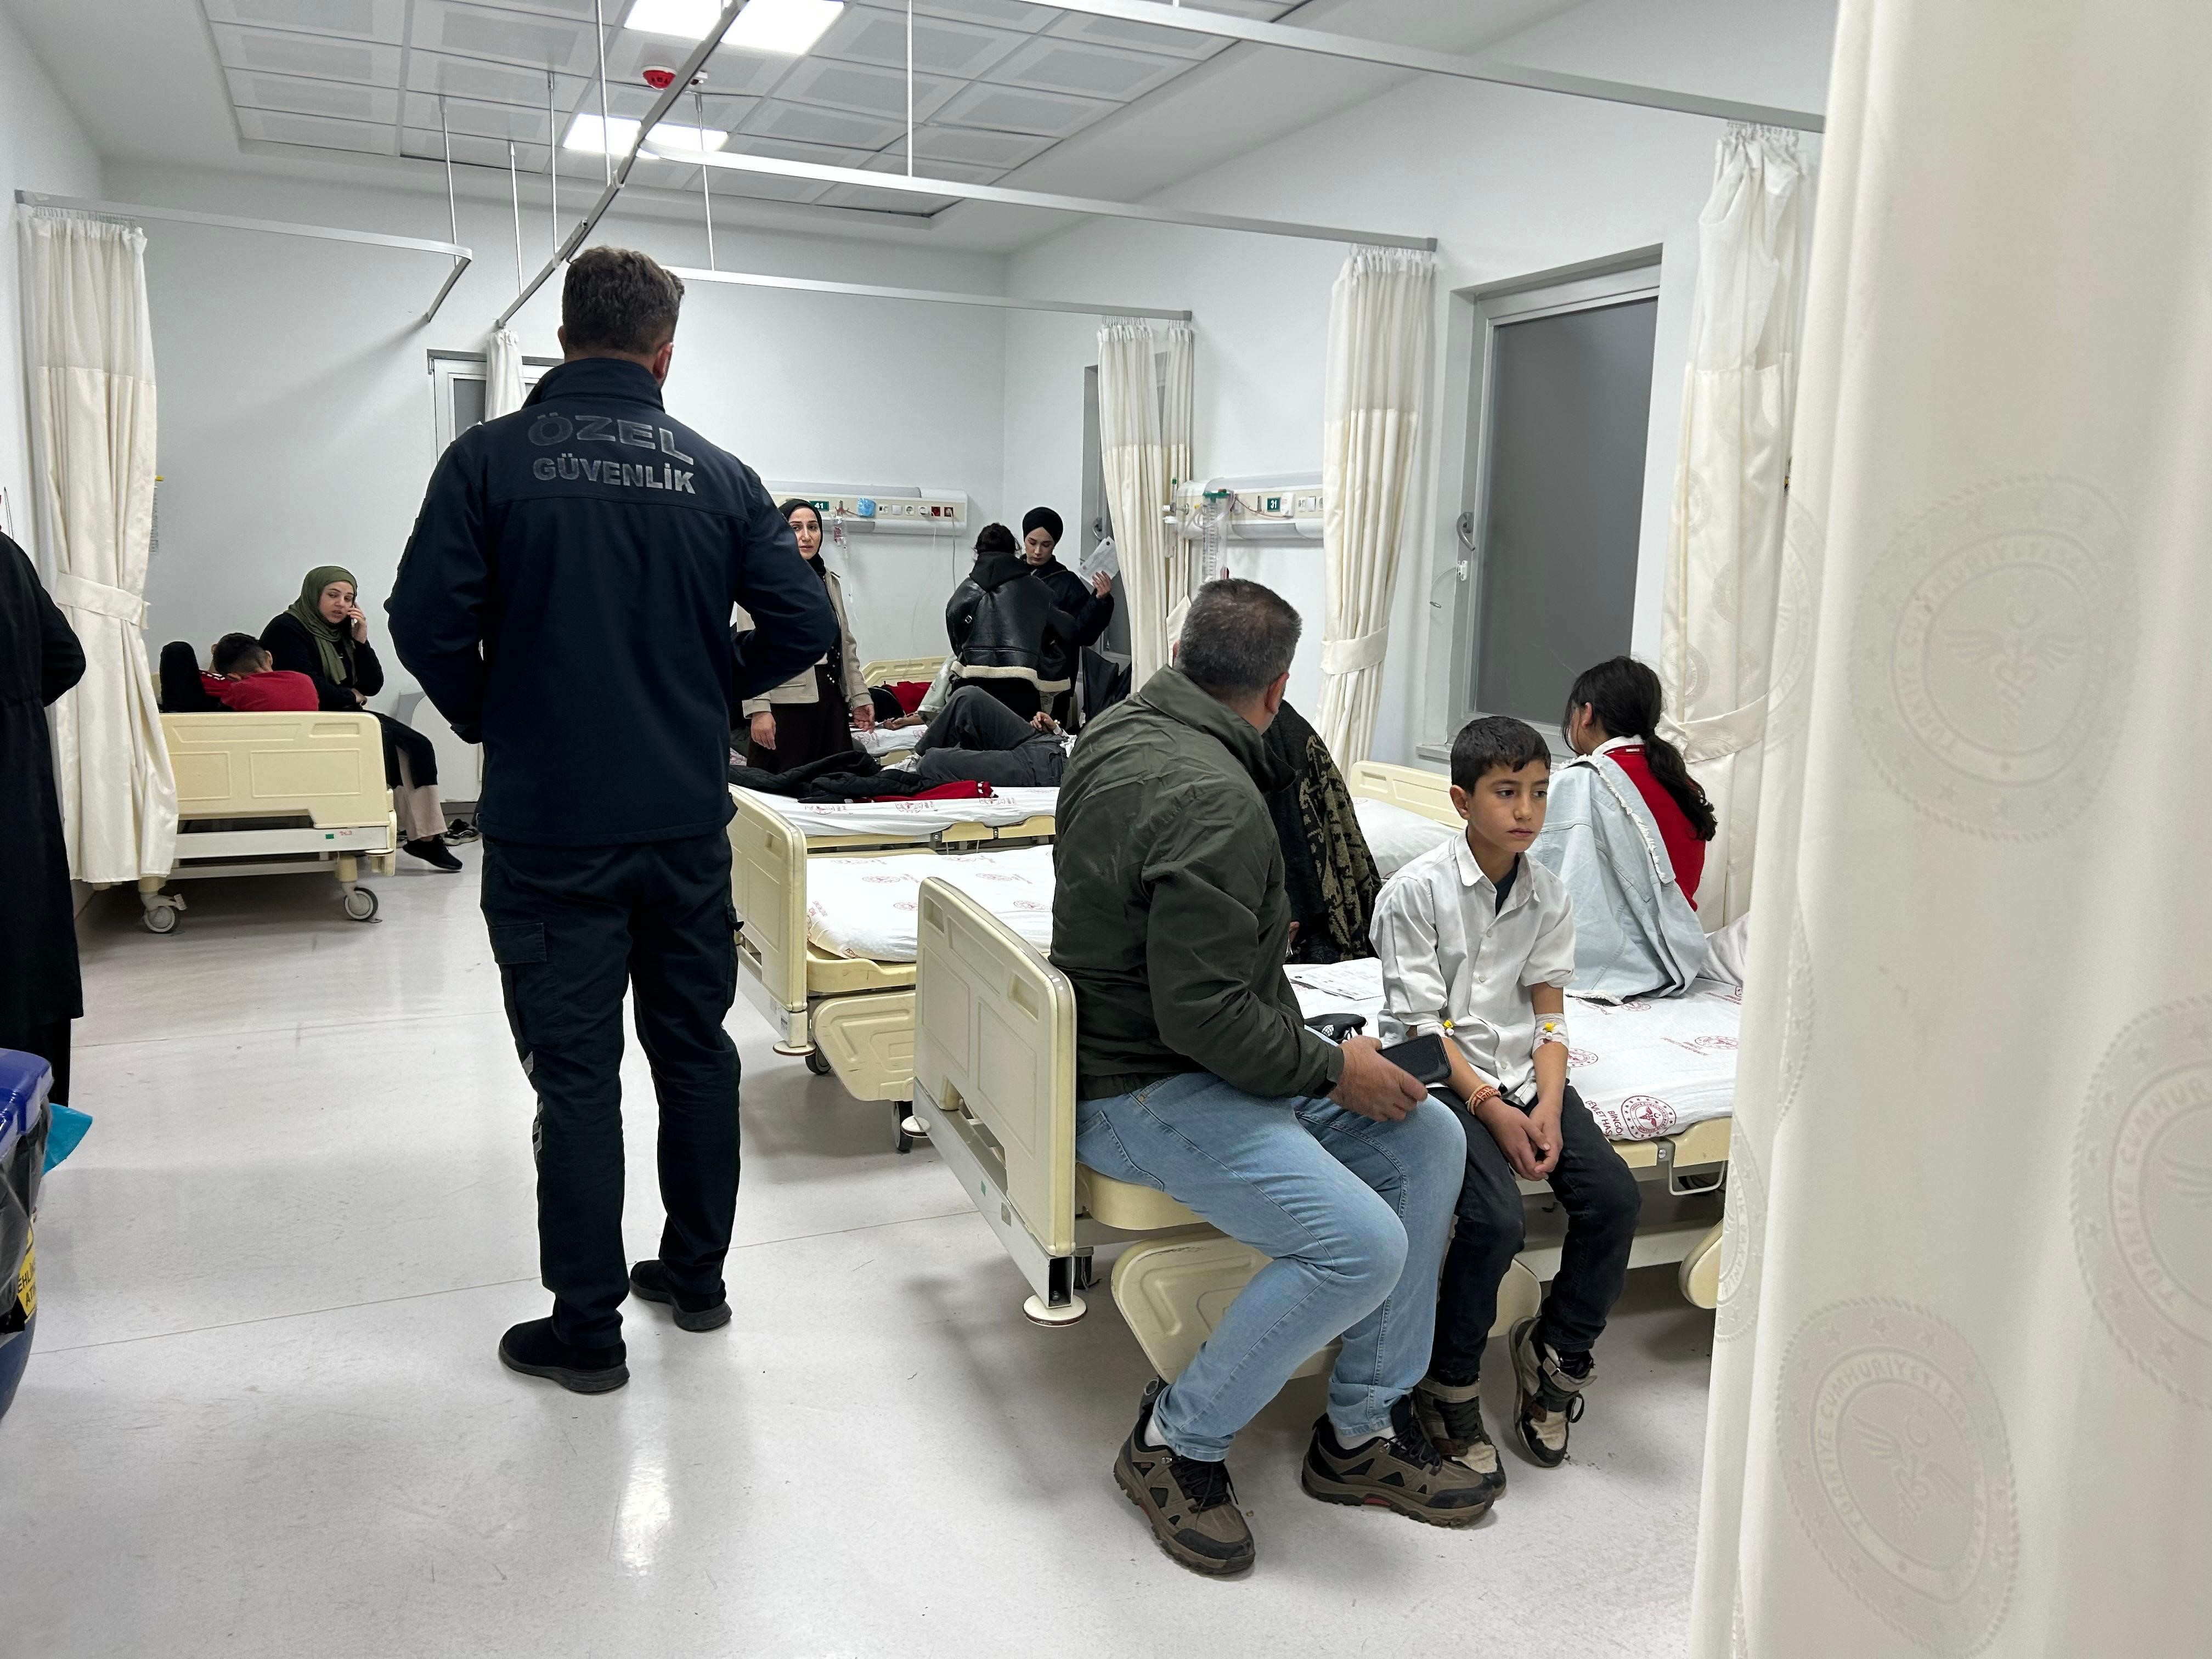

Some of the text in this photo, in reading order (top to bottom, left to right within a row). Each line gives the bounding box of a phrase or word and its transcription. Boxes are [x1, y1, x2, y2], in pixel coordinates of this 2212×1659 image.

[528, 413, 693, 465] ÖZEL
[533, 453, 695, 494] GÜVENLİK
[1270, 500, 1277, 509] 31
